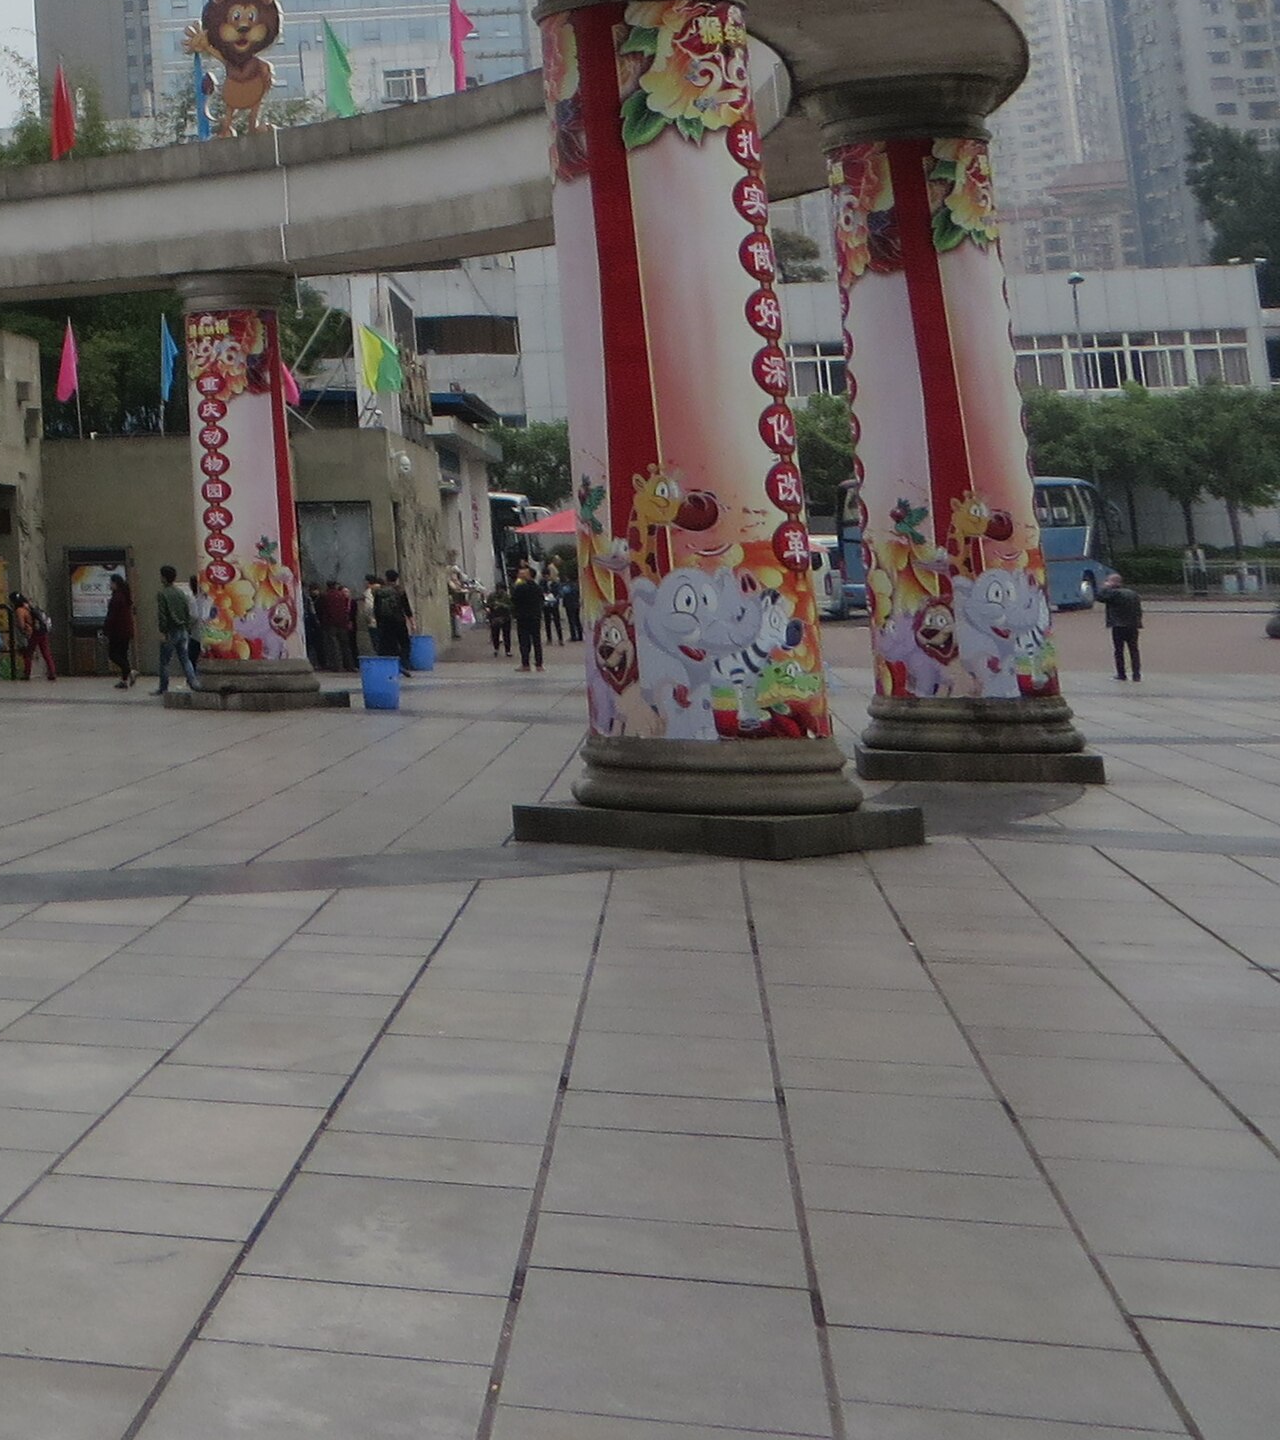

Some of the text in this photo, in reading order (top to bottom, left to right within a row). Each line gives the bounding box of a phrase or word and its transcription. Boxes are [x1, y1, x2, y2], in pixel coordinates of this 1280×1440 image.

[199, 376, 229, 582] 重庆动物园欢迎您
